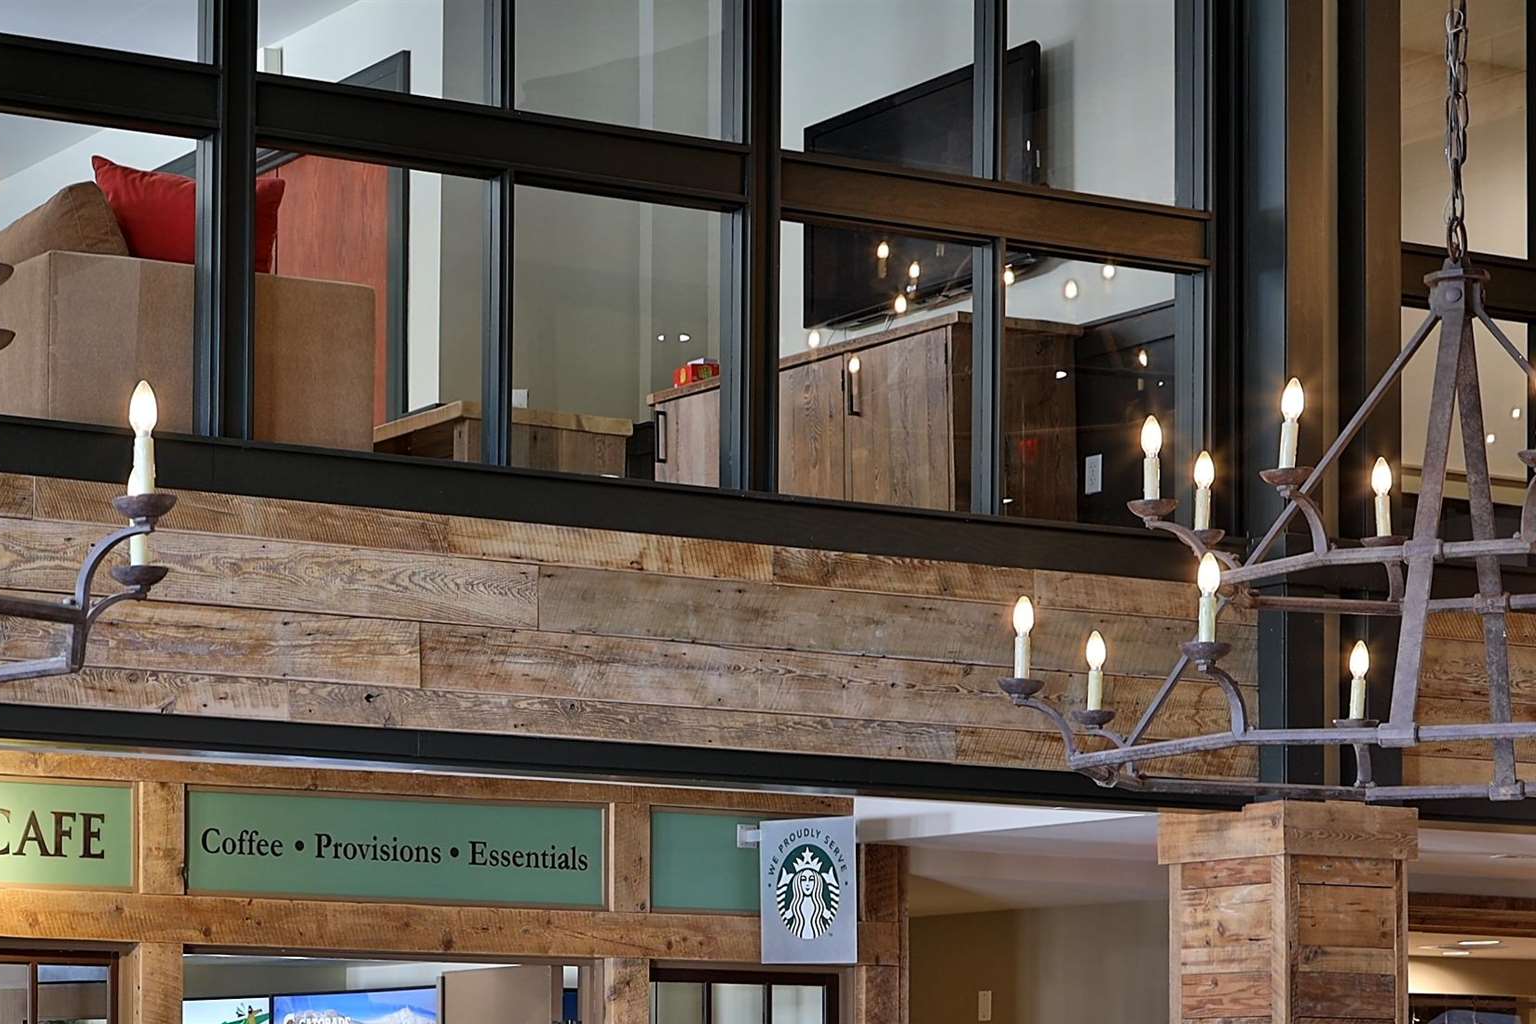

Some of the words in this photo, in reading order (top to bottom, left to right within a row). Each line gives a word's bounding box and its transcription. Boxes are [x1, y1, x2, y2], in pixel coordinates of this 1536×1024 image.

[200, 827, 284, 857] Coffee
[314, 833, 443, 865] Provisions
[467, 840, 589, 872] Essentials
[768, 855, 780, 876] WE
[777, 827, 822, 854] PROUDLY
[823, 835, 848, 873] SERVE
